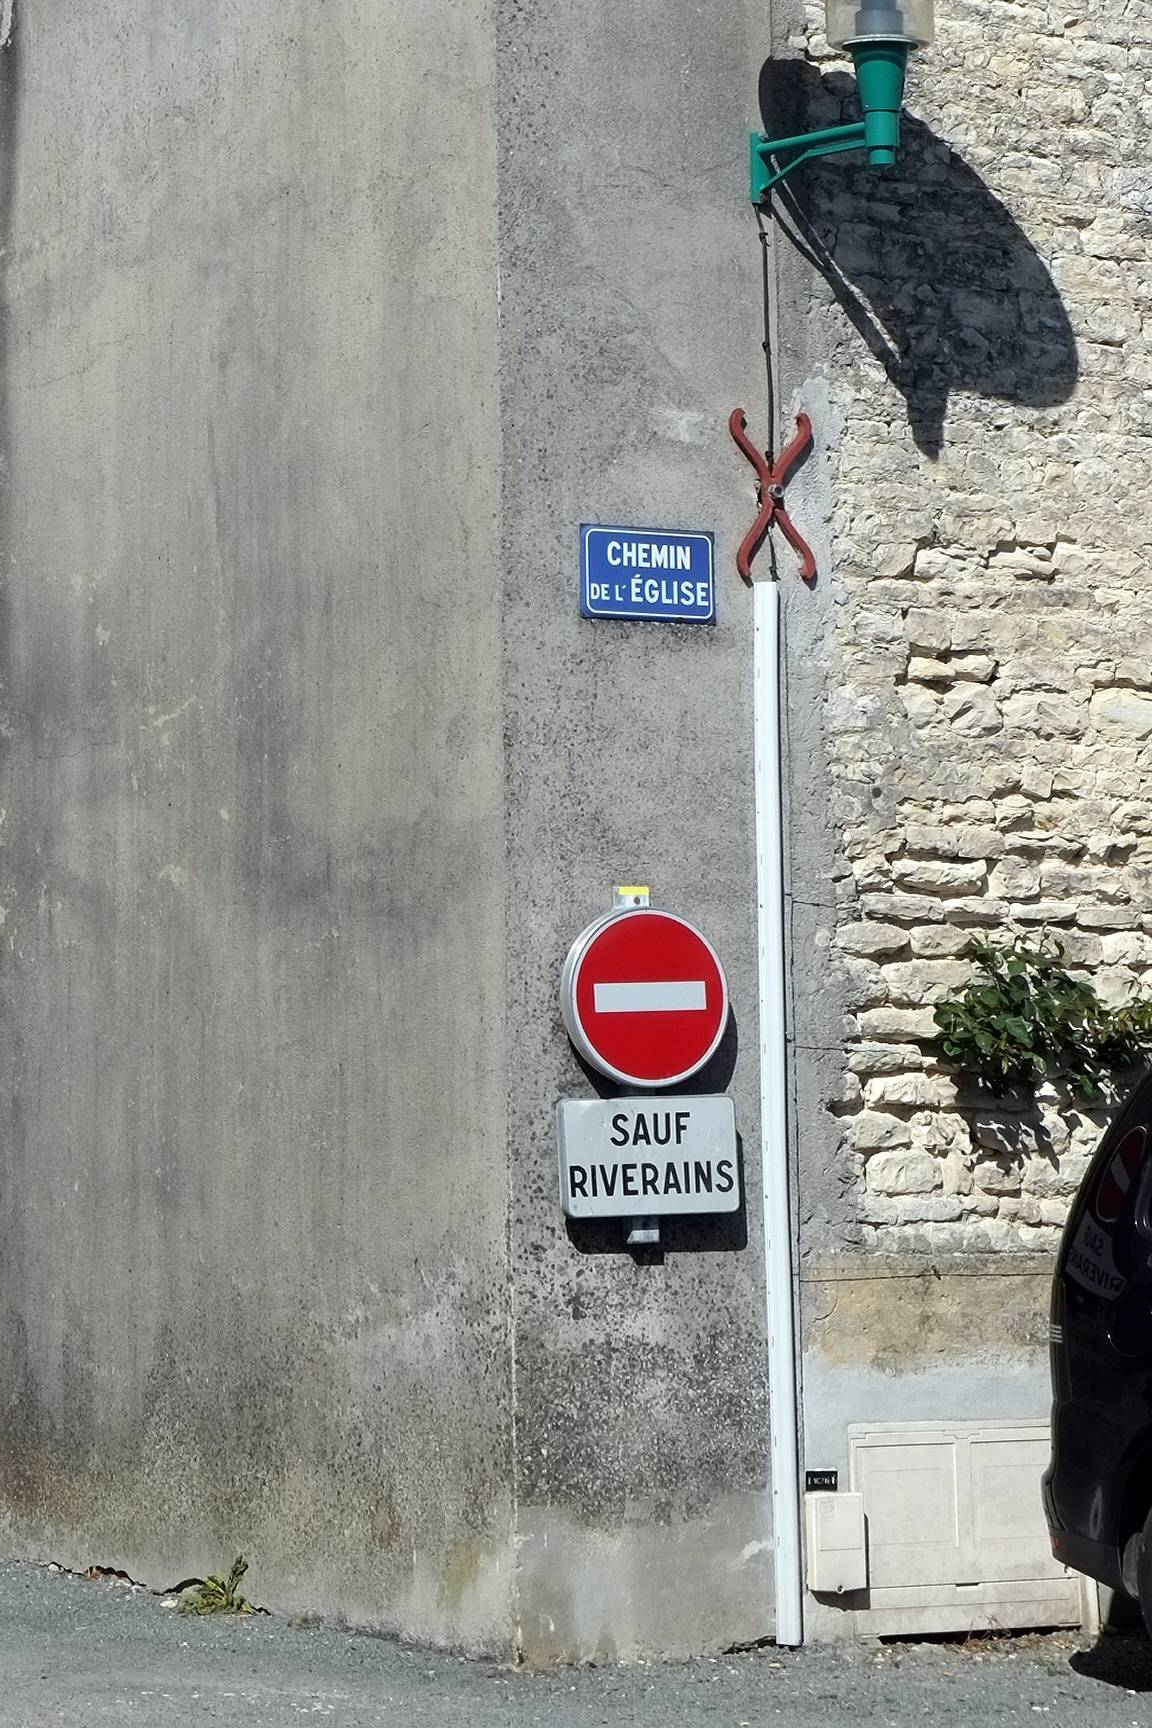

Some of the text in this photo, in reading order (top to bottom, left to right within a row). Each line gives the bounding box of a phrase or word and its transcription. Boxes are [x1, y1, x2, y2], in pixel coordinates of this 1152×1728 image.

[607, 541, 691, 570] CHEMIN
[591, 583, 610, 600] DE
[610, 1112, 691, 1147] SAUF
[569, 1159, 735, 1198] RIVERAINS
